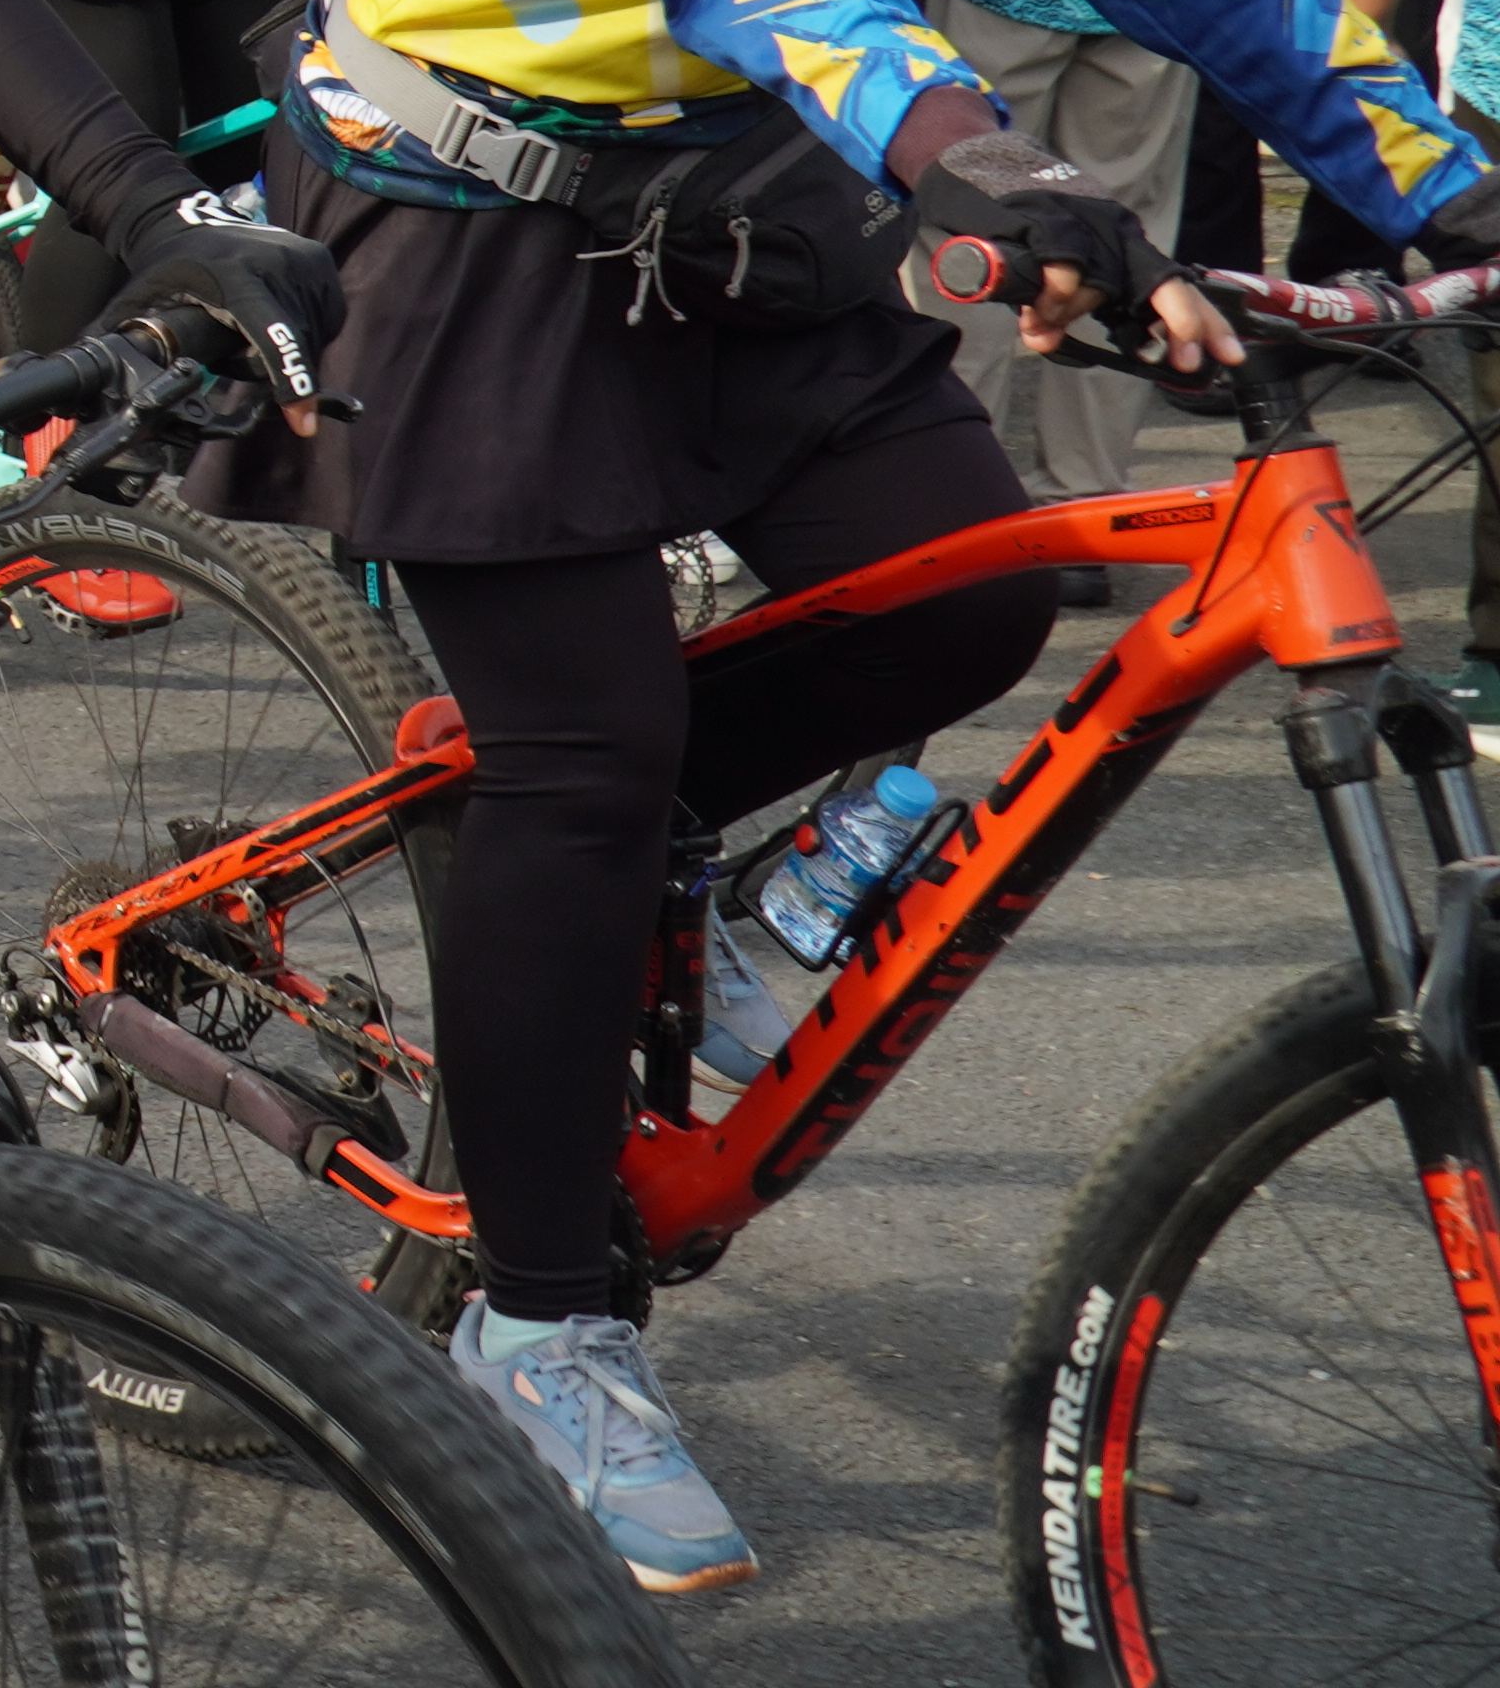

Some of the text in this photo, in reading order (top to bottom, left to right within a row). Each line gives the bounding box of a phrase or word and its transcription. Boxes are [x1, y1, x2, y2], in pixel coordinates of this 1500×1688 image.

[266, 322, 314, 397] GIYO
[87, 1369, 186, 1414] ENTITY
[1041, 1285, 1116, 1650] KENDATIRE.COM
